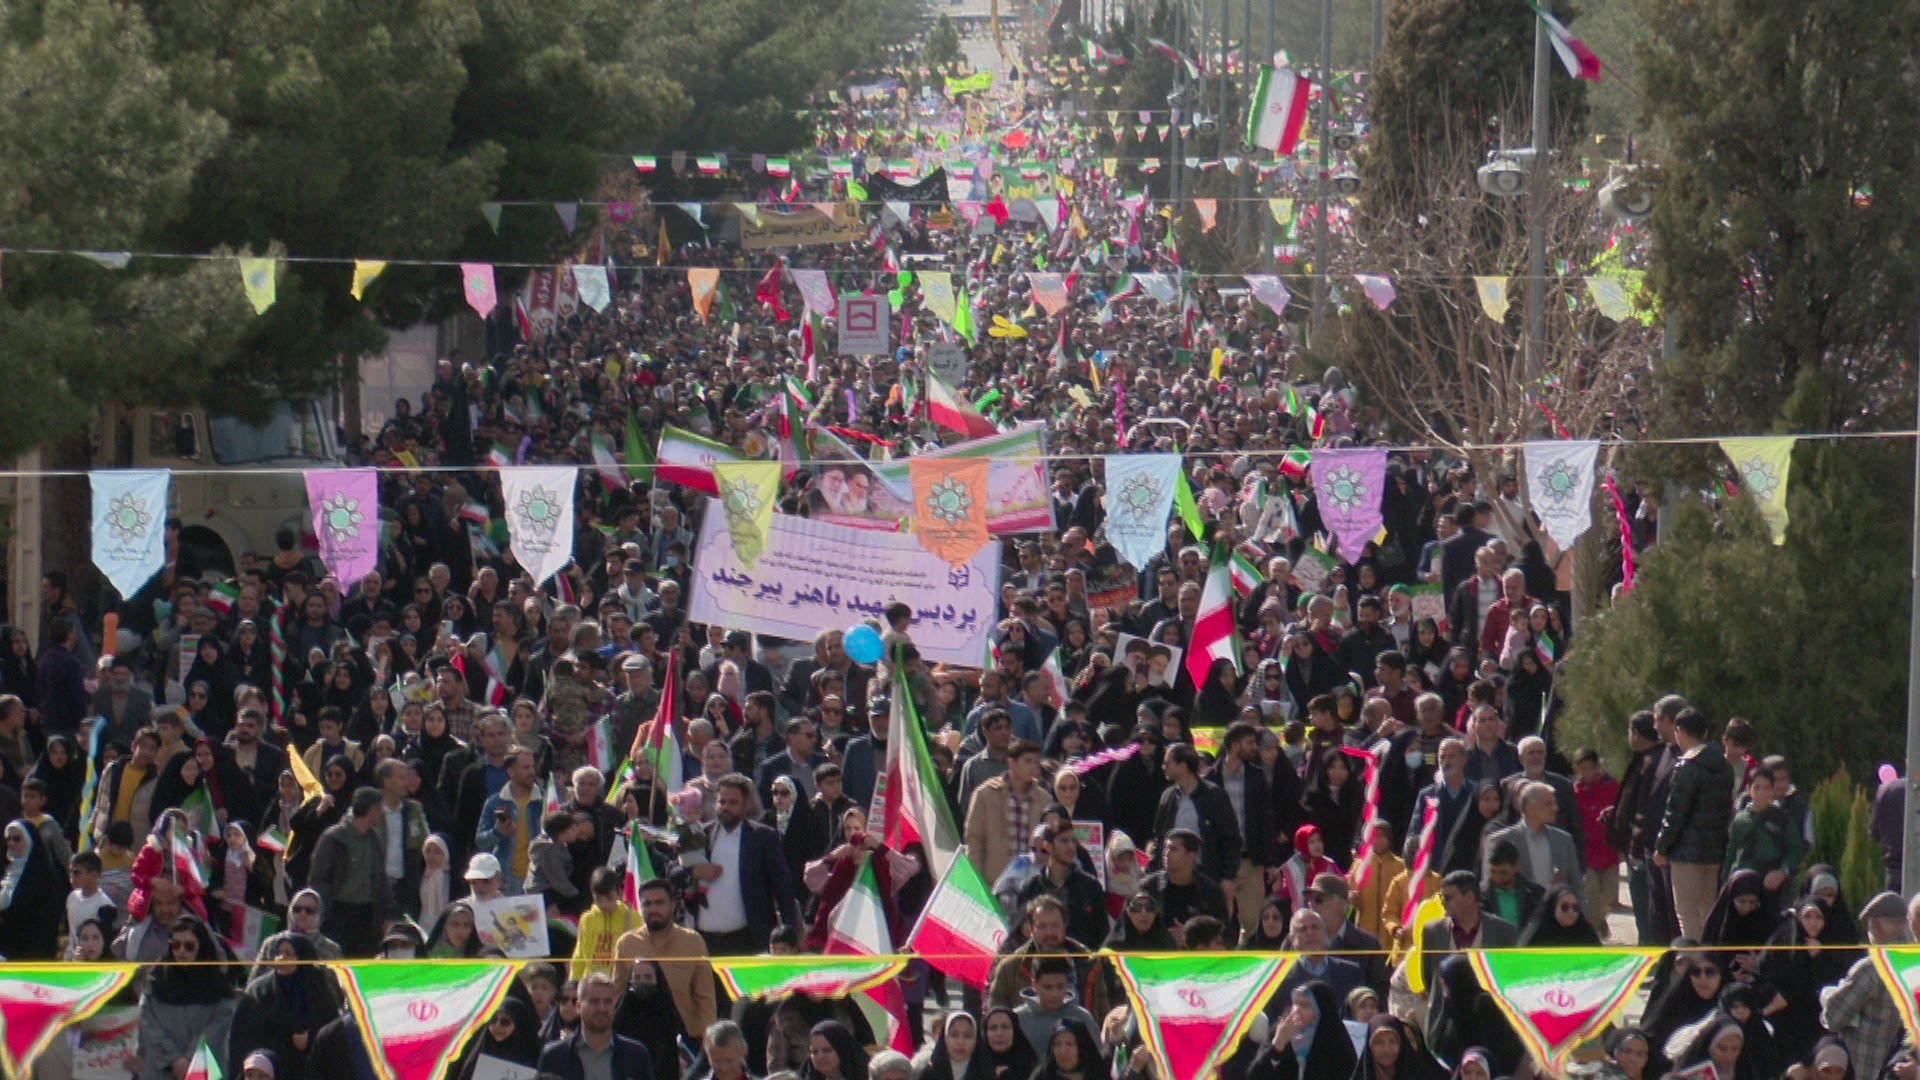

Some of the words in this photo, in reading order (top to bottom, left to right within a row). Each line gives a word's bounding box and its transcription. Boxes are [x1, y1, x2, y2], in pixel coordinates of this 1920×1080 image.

[712, 567, 783, 604] بیرجند
[787, 583, 840, 614] باهنر
[908, 603, 977, 630] پردیس
